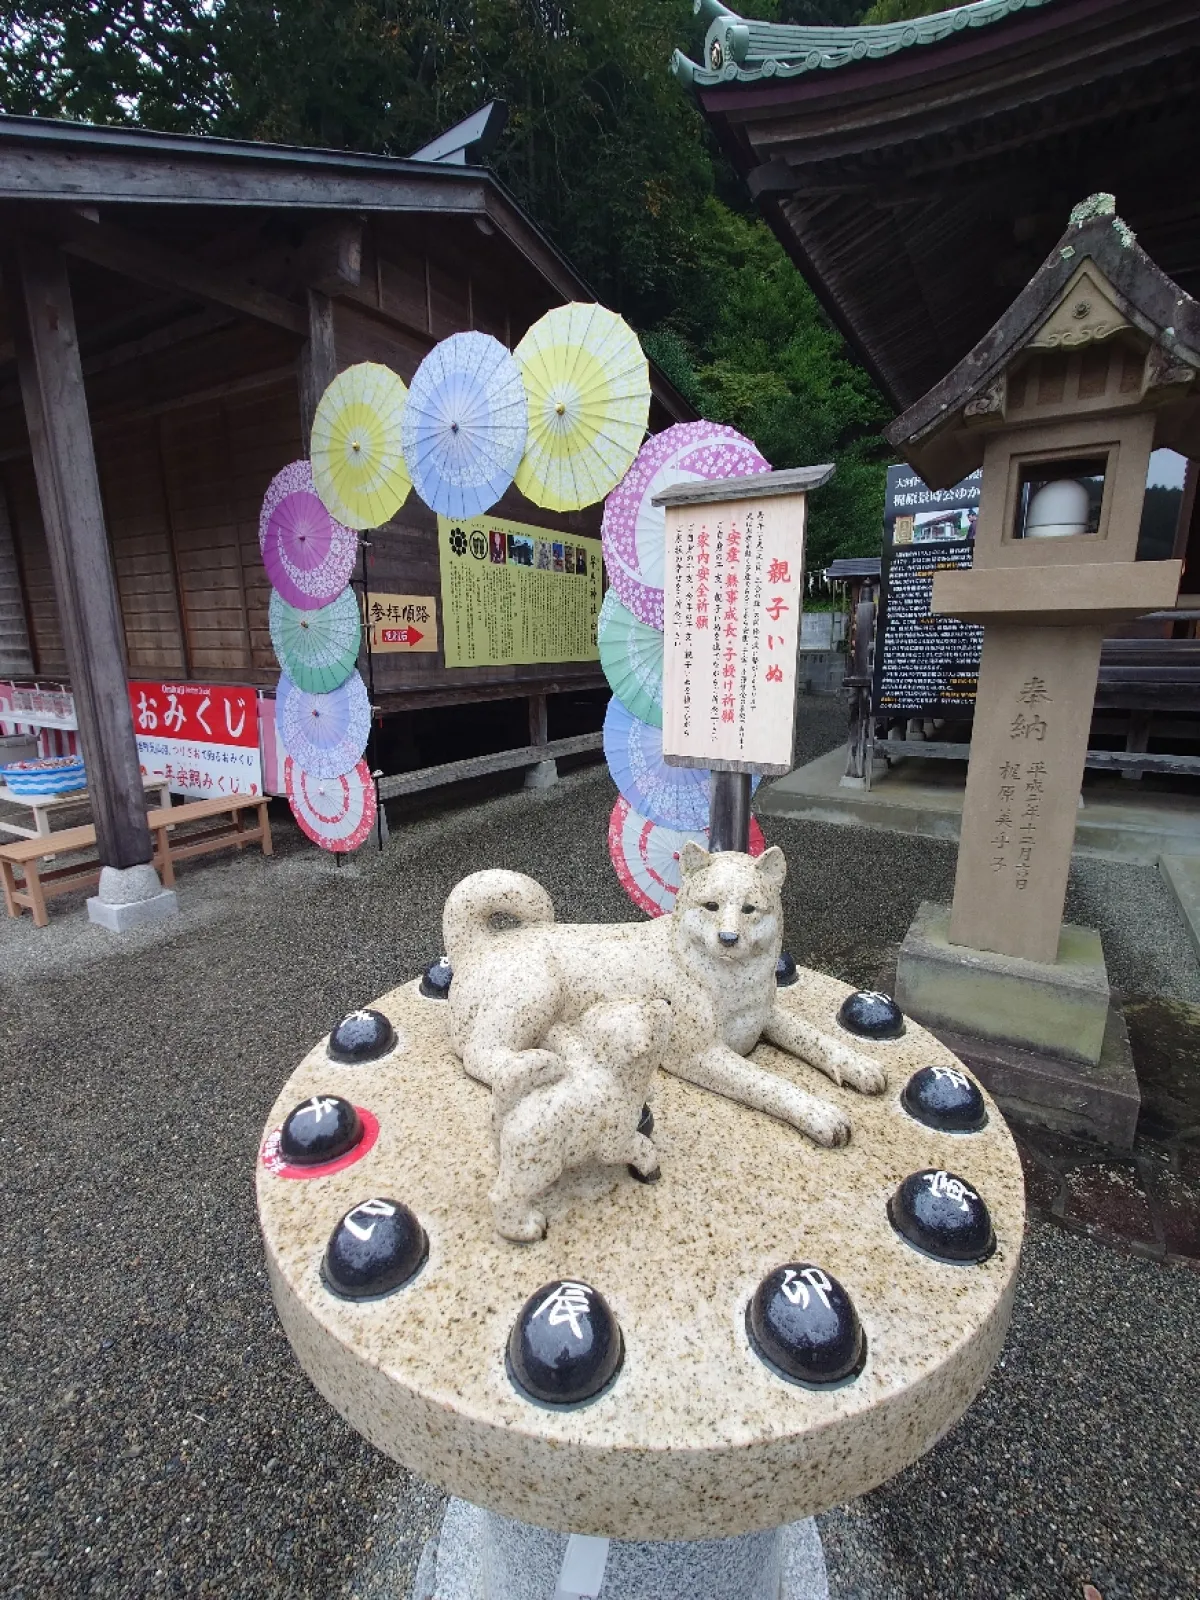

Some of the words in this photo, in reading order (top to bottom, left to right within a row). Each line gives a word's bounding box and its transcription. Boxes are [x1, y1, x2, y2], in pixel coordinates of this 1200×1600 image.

[765, 558, 792, 683] 親子いぬ
[137, 691, 246, 738] おみくじ
[1010, 676, 1053, 742] 奉納
[923, 1171, 978, 1211] 寅
[532, 1281, 593, 1339] 辰
[781, 1268, 832, 1310] 卯
